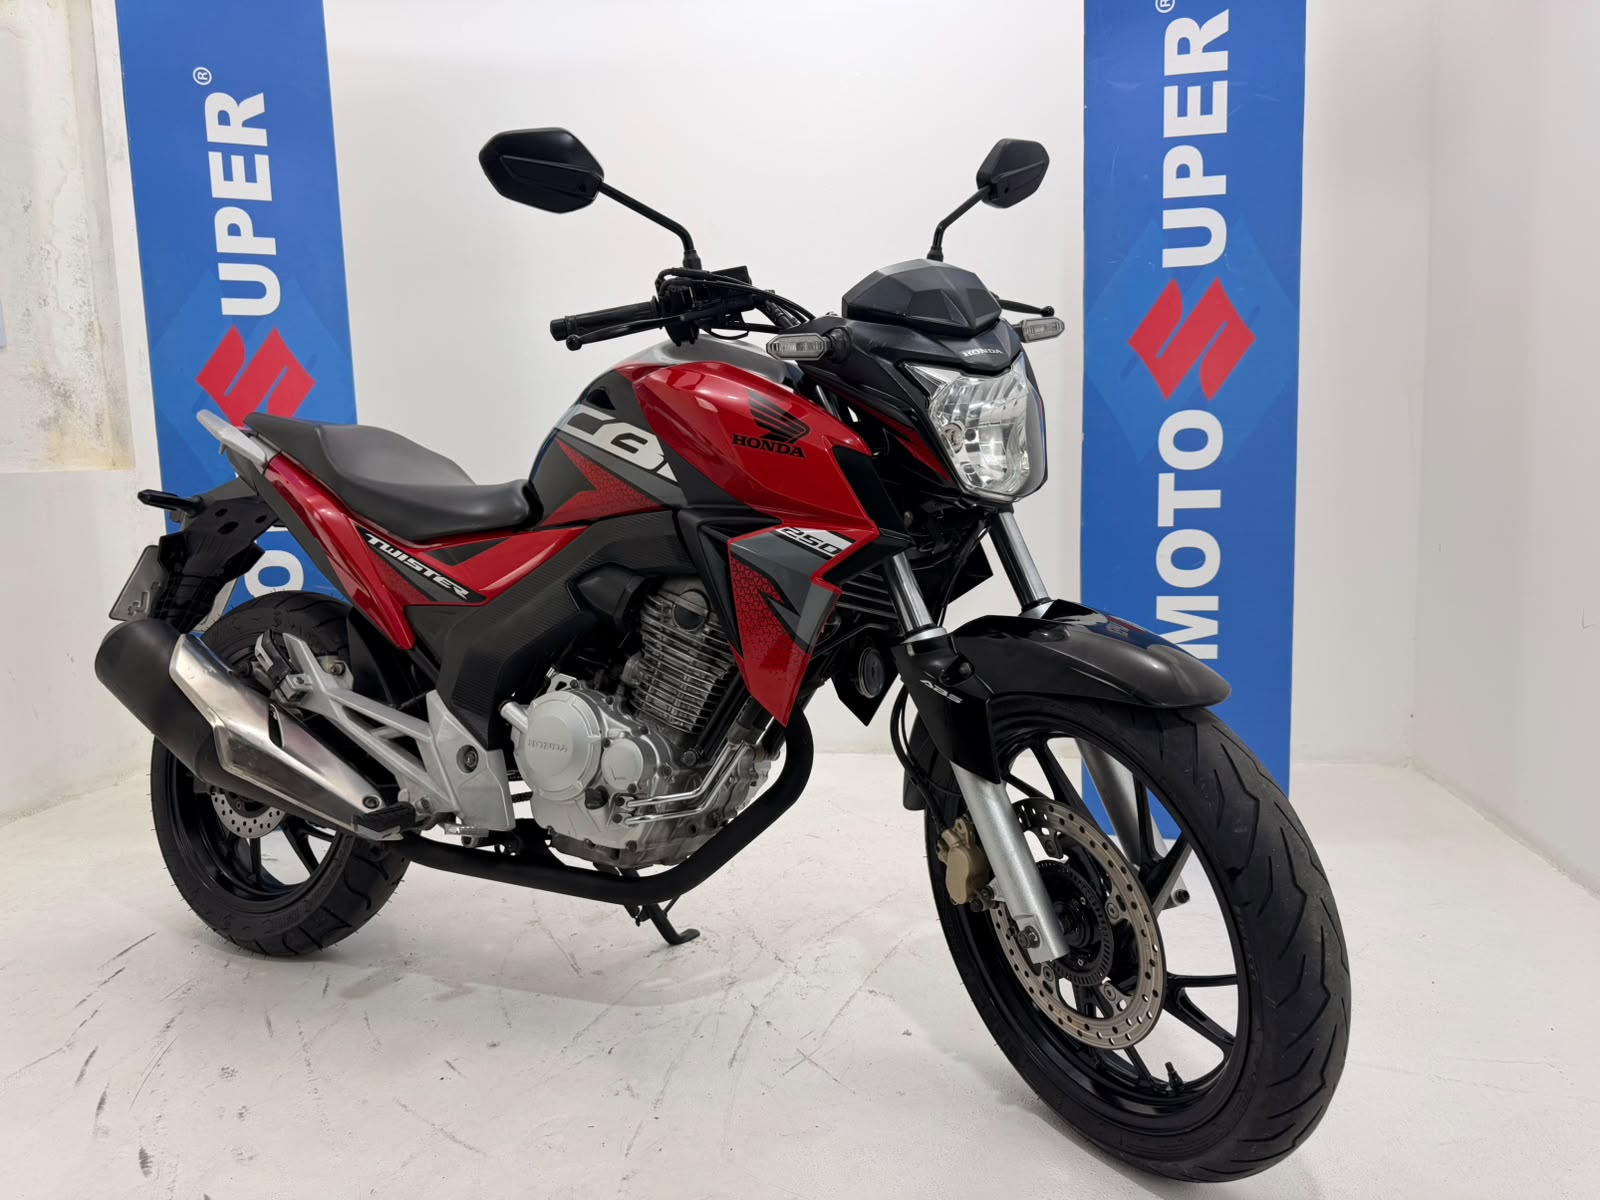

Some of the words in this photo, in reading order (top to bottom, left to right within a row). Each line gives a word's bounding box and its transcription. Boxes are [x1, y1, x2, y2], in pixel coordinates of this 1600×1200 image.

[962, 348, 1004, 357] HONDA
[732, 433, 806, 458] HONDA
[781, 527, 845, 555] 250
[1156, 409, 1223, 659] MOTO
[366, 533, 470, 600] TWISTER
[920, 680, 963, 703] ABS
[528, 740, 568, 753] HONDA
